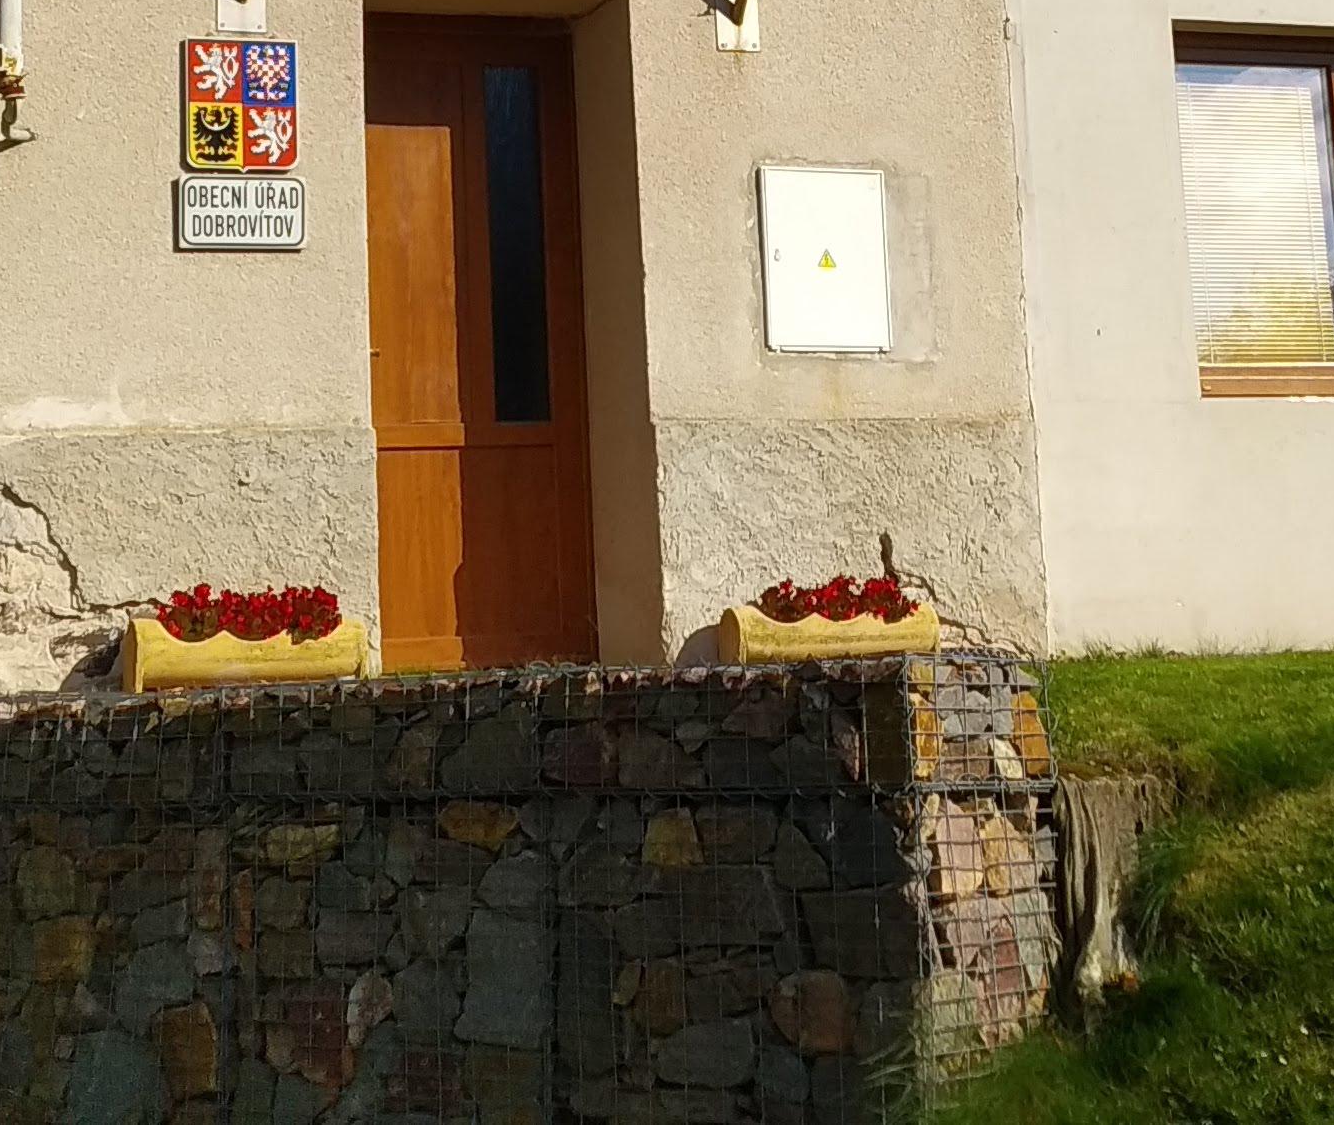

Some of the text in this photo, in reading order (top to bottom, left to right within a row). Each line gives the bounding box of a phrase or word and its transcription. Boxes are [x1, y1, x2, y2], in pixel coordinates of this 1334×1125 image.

[187, 181, 299, 209] OBECNÍ ÚŘAD
[192, 210, 294, 237] DOBROVÍTOV
